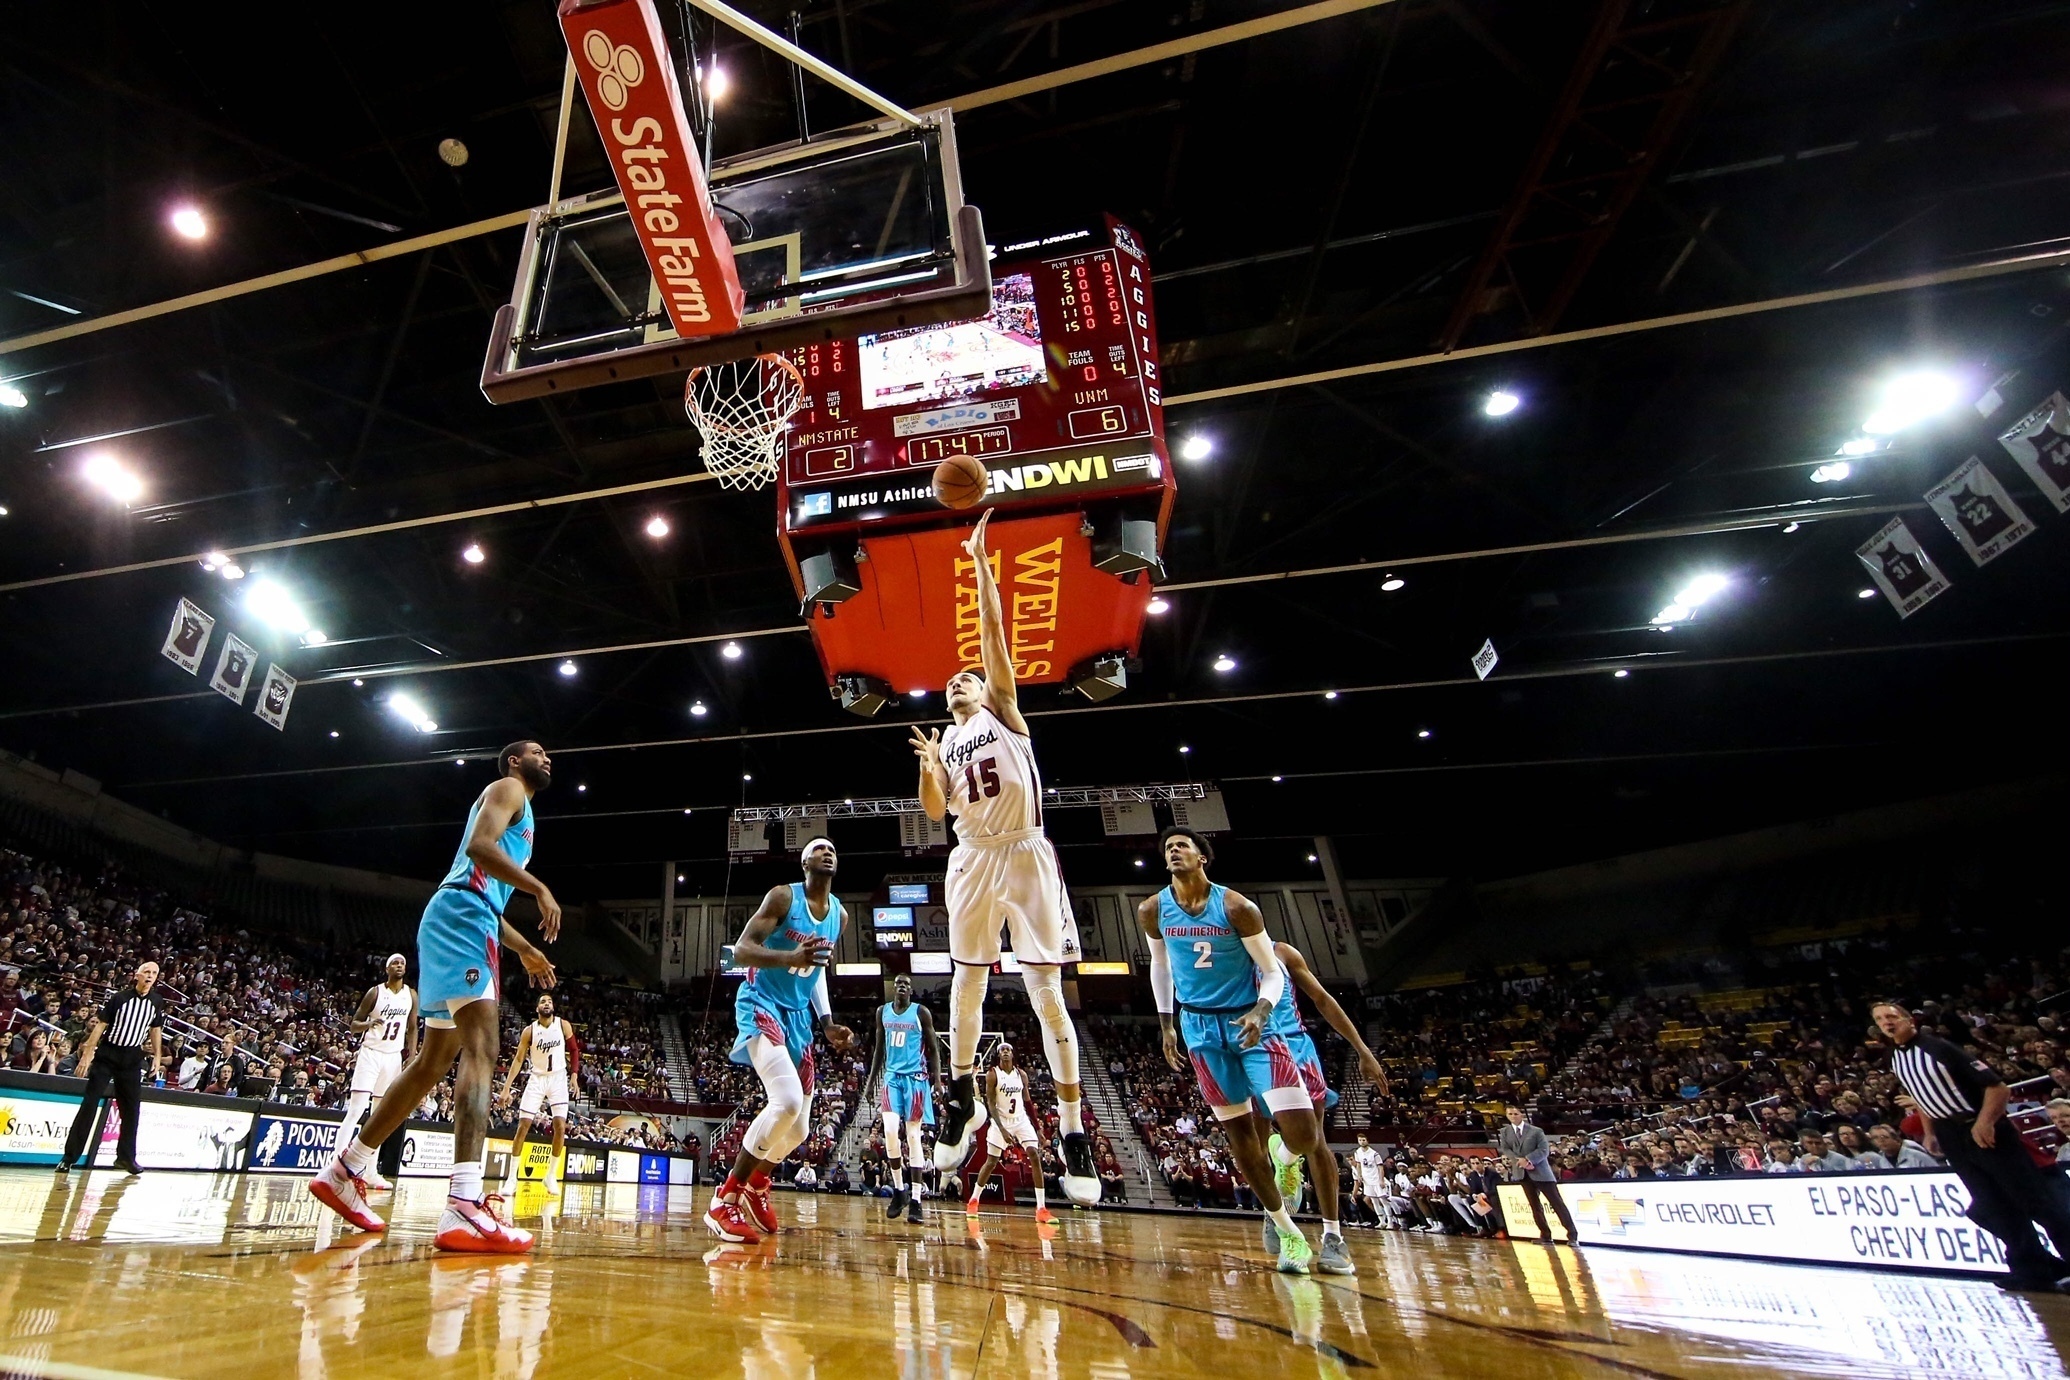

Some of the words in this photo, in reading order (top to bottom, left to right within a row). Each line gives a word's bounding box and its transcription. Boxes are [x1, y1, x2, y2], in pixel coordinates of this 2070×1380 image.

[1003, 240, 1041, 252] UNDER
[1041, 230, 1090, 245] ARMOUR
[1051, 261, 1068, 270] PLYR
[1073, 257, 1085, 265] FLS
[1093, 254, 1106, 262] PTS
[1062, 269, 1070, 280] 2
[1076, 267, 1086, 277] 0
[1102, 262, 1111, 272] 0
[1063, 282, 1073, 293] 5
[1079, 279, 1088, 290] 0
[1105, 275, 1113, 285] 2
[1061, 295, 1075, 306] 10
[1081, 292, 1091, 303] 0
[1107, 288, 1116, 298] 2
[1083, 305, 1093, 316] 0
[1109, 301, 1119, 311] 0
[1065, 321, 1080, 332] 15
[1086, 318, 1096, 329] 0
[1112, 314, 1121, 325] 2
[1130, 265, 1160, 406] AGGIES
[810, 353, 819, 364] 0
[832, 349, 841, 360] 2
[1068, 350, 1091, 359] TEAM
[1068, 356, 1094, 366] FOULS
[811, 365, 819, 376] 0
[833, 361, 842, 372] 0
[1084, 366, 1097, 382] 0
[1113, 362, 1127, 375] 4
[1074, 388, 1109, 405] UNM
[828, 407, 840, 419] 4
[1101, 409, 1119, 431] 6
[983, 430, 1005, 438] PERIOD
[833, 449, 847, 469] 2
[837, 491, 878, 509] NMSU
[883, 486, 937, 503] Athlet
[1966, 503, 1993, 526] 22
[1892, 561, 1913, 580] 31
[1010, 537, 1063, 679] WELLS
[185, 629, 194, 640] 7
[945, 729, 998, 768] Aggies
[964, 756, 1001, 804] 15
[888, 875, 909, 883] NEW
[911, 874, 945, 883] MEXIC
[887, 912, 909, 920] pepsi
[875, 932, 913, 943] ENDWI
[1164, 927, 1187, 937] NEW
[1193, 941, 1213, 969] 2
[380, 1003, 408, 1021] Aggies
[382, 1021, 401, 1041] 13
[890, 1031, 906, 1048] 10
[536, 1038, 561, 1054] Aggies
[547, 1054, 553, 1072] 1
[1008, 1098, 1017, 1114] 3
[8, 1139, 64, 1150] lcsun-news.c
[286, 1123, 338, 1148] PIONE
[528, 1154, 551, 1164] ROOT
[531, 1145, 551, 1155] ROTO
[297, 1151, 335, 1169] BANK
[493, 1153, 508, 1178] #1
[567, 1153, 596, 1174] ENDWI
[1807, 1186, 1838, 1216] EL
[1837, 1183, 1966, 1218] PASO-LAS
[1656, 1203, 1776, 1226] CHEVROLET
[1850, 1225, 1930, 1260] CHEVY
[1935, 1227, 2007, 1265] DEAL
